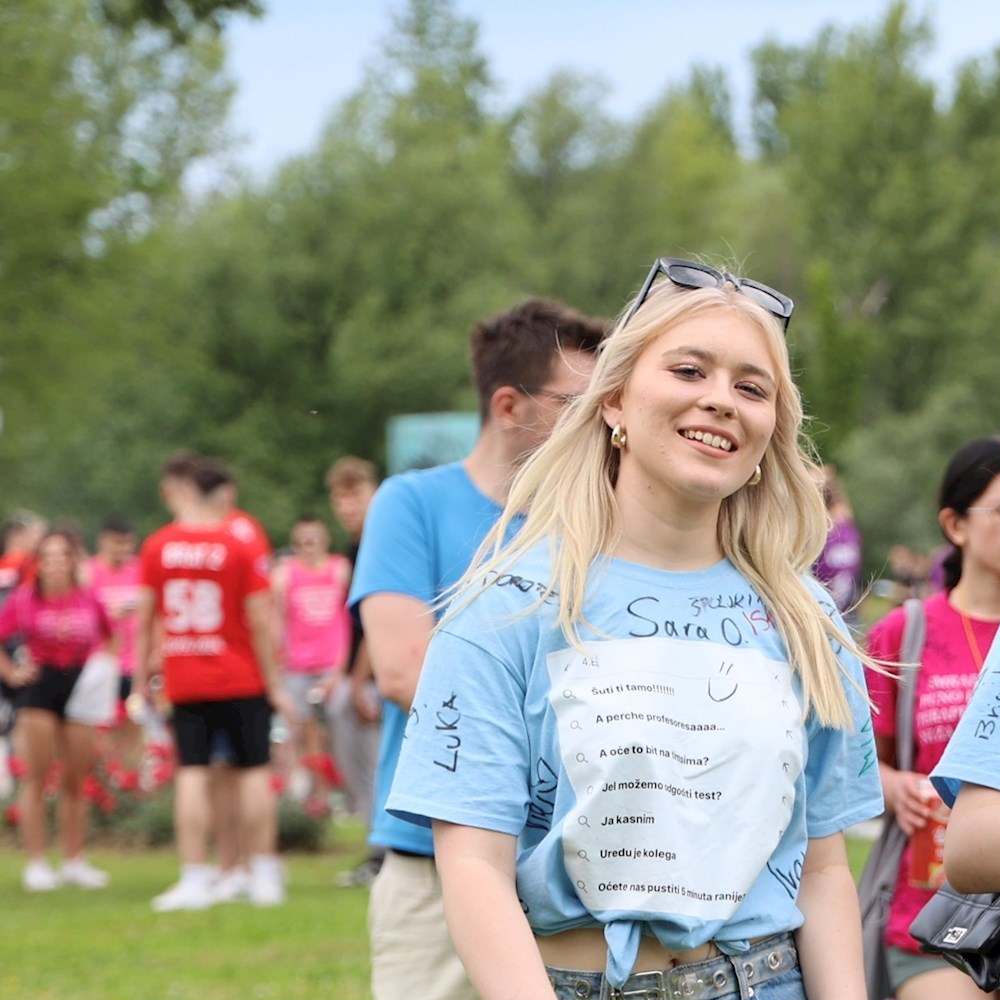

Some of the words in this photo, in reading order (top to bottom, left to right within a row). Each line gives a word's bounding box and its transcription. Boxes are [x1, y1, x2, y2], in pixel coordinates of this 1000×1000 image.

[627, 596, 710, 640] Sara
[591, 686, 614, 696] Šuti
[616, 684, 624, 693] ti
[595, 715, 604, 723] A
[606, 712, 644, 723] perche
[433, 691, 461, 773] LUKA
[600, 749, 607, 758] A
[632, 746, 643, 754] to
[646, 746, 657, 755] bit
[659, 750, 670, 758] na
[602, 782, 616, 792] Jel
[618, 779, 663, 790] možemo
[694, 791, 721, 801] test?
[601, 817, 614, 826] Ja
[616, 814, 654, 824] kasnim
[600, 848, 632, 859] Uredu
[633, 848, 641, 859] je
[643, 849, 676, 861] kolega
[598, 882, 628, 891] Oćete
[630, 884, 646, 892] nas
[647, 884, 680, 894] pustiti
